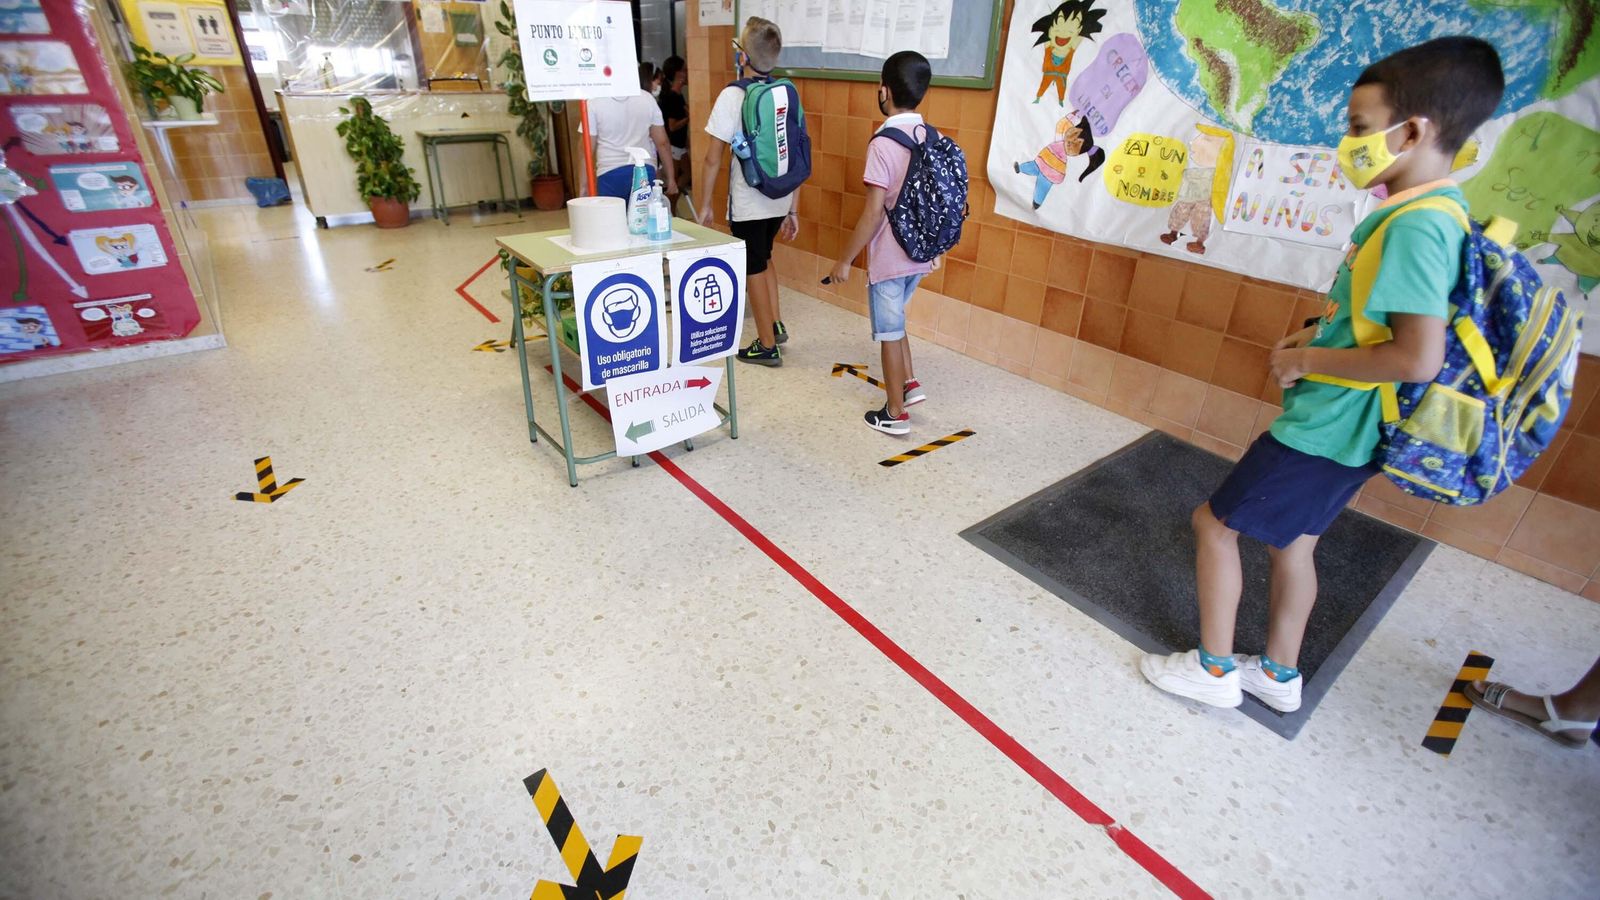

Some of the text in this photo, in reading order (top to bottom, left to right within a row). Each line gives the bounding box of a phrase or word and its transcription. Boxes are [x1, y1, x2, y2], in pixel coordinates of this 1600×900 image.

[530, 24, 563, 39] PUNTO
[1106, 49, 1142, 97] CRECER
[1160, 147, 1185, 164] UN
[1245, 148, 1264, 180] A
[1116, 179, 1175, 203] NOMBRE
[1231, 190, 1343, 237] NIÑOS
[705, 324, 728, 337] soluciones
[597, 345, 652, 366] Uso obligatorio
[691, 341, 724, 355] desinfectantes
[601, 360, 650, 379] de mascarilla
[615, 380, 681, 408] ENTRADA
[662, 403, 706, 429] SALIDA
